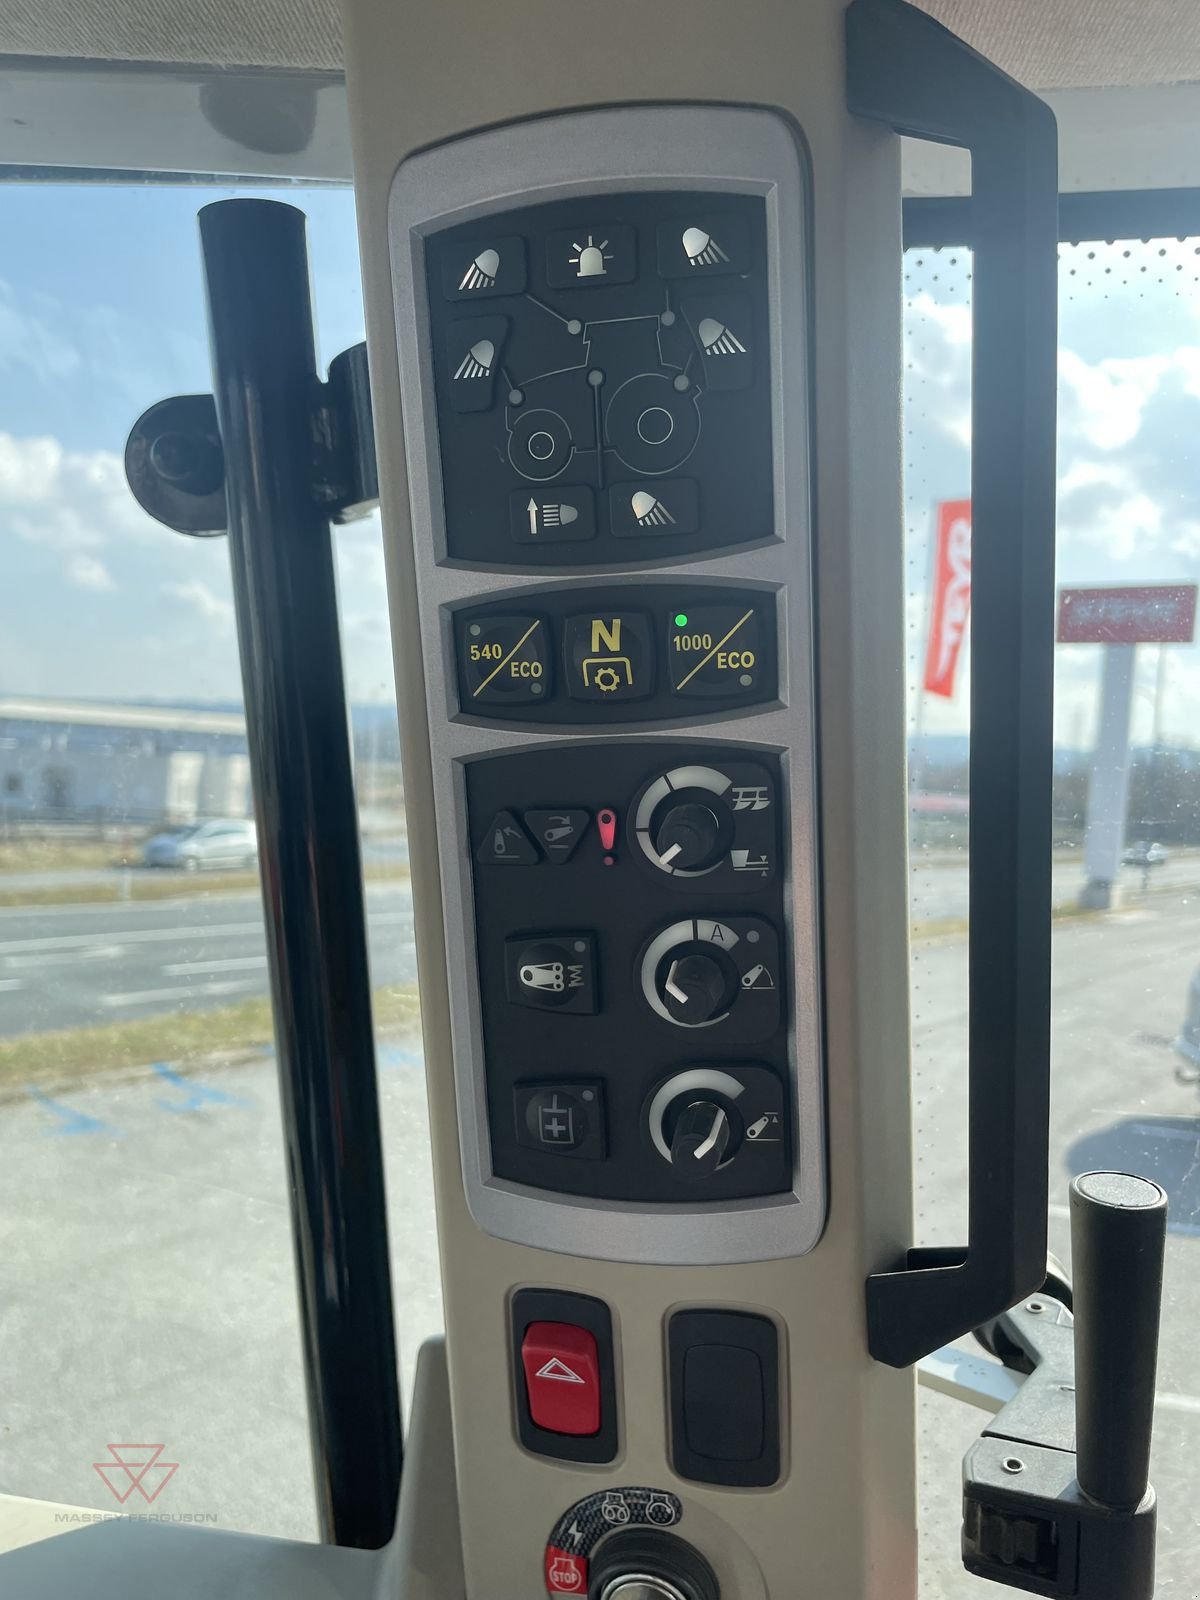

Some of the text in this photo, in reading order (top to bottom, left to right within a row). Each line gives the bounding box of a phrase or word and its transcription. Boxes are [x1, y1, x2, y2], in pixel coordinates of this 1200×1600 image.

[591, 618, 621, 652] N
[673, 634, 711, 651] 1000
[470, 644, 502, 661] 540
[717, 651, 755, 669] ECO
[510, 661, 542, 678] ECO
[710, 924, 724, 941] A
[552, 1569, 578, 1583] STOP
